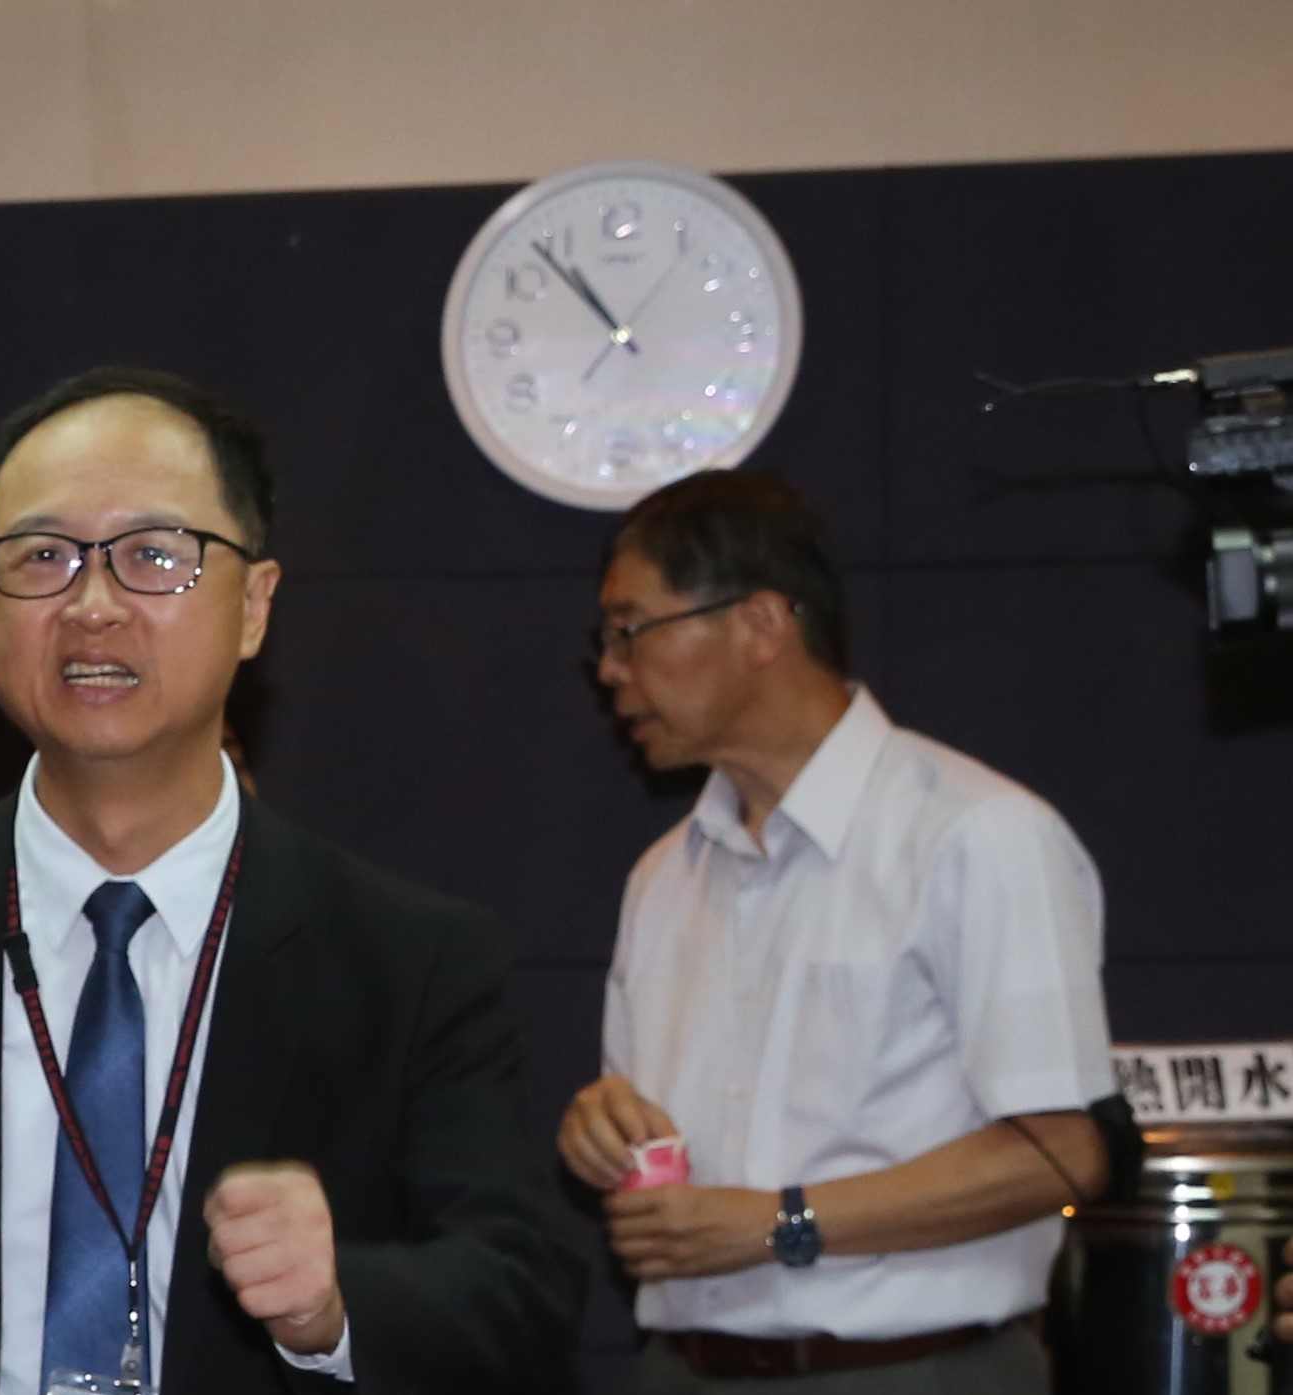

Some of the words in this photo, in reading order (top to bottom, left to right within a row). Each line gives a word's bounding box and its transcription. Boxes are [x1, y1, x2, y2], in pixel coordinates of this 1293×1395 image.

[601, 202, 642, 241] 12
[505, 263, 548, 301] 10
[485, 318, 521, 360] 9
[506, 373, 539, 414] 8
